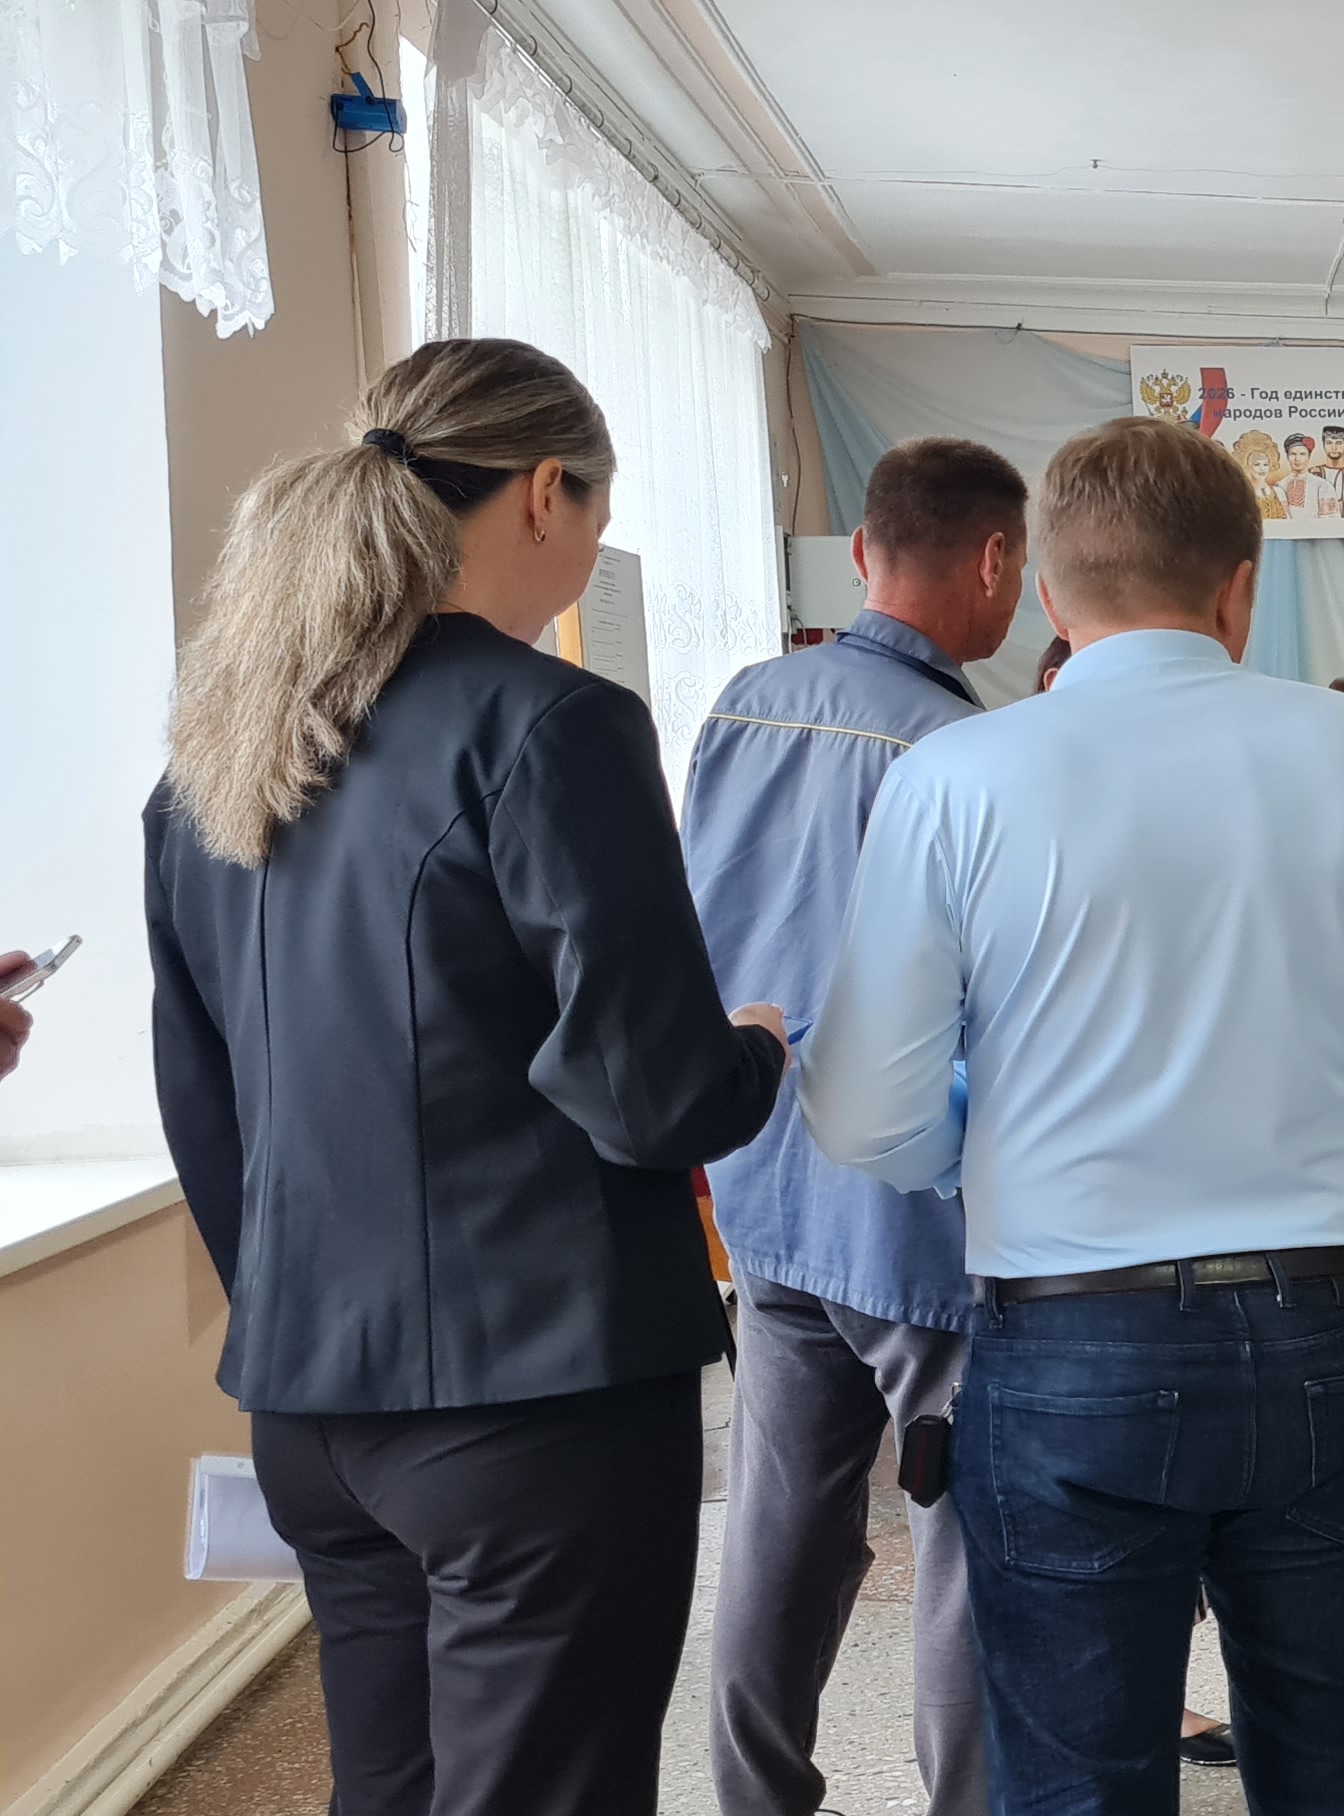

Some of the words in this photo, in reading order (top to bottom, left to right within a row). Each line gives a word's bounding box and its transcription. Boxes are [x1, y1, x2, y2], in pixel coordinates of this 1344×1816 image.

[1198, 387, 1235, 400] 2026
[1251, 387, 1280, 402] Год
[1213, 407, 1283, 421] народов
